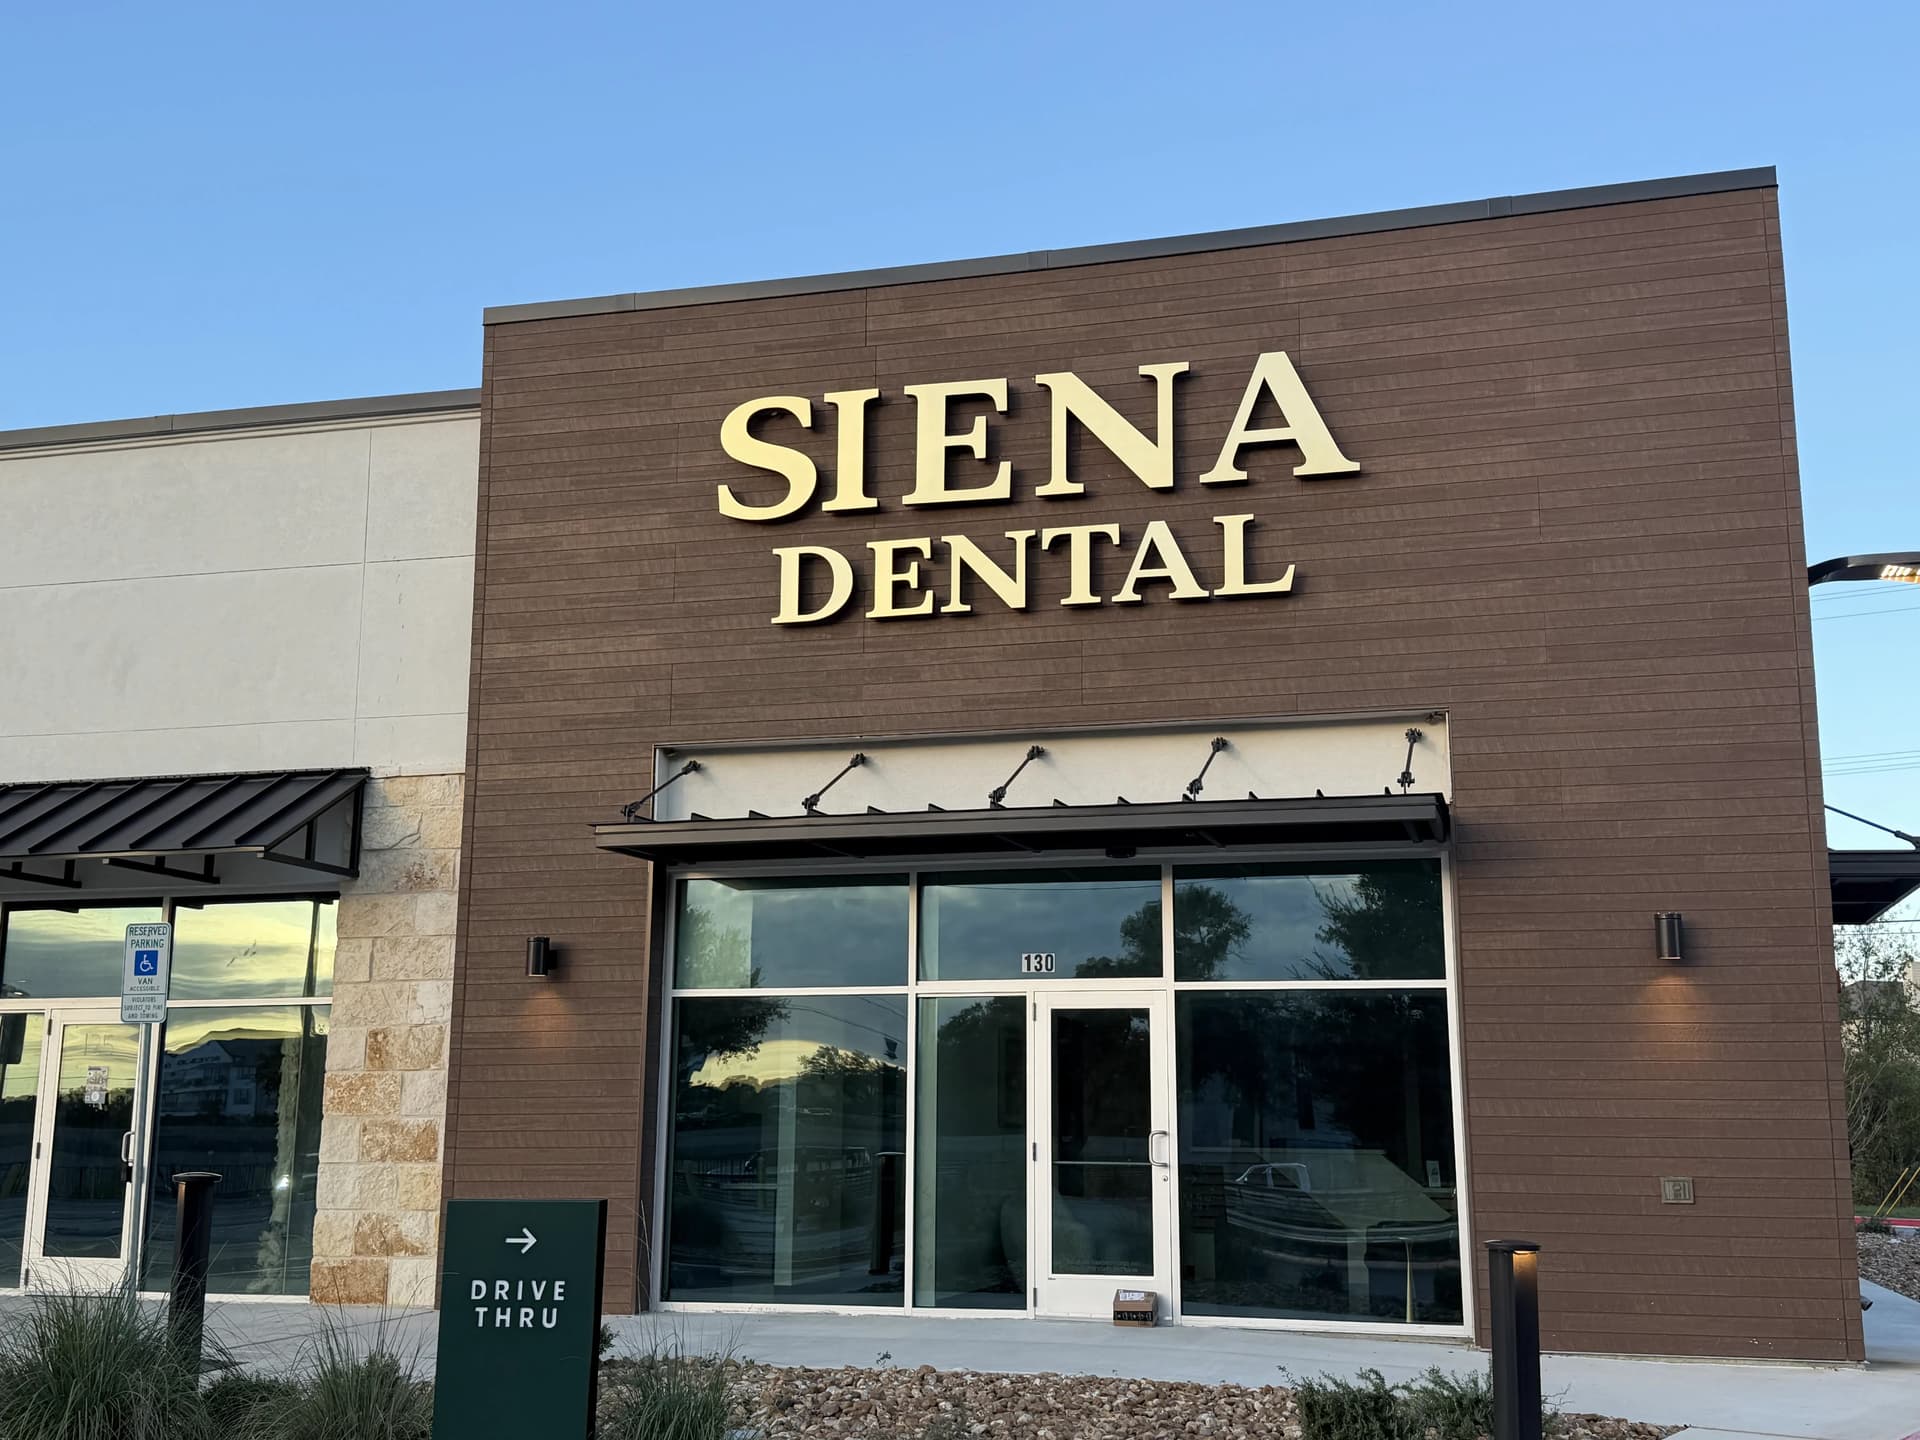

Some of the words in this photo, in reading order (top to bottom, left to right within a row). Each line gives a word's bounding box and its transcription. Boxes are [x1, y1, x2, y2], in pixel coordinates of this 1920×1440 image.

[717, 351, 1361, 521] SIENA
[771, 513, 1295, 625] DENTAL
[129, 926, 167, 936] RESERVED
[130, 939, 164, 948] PARKING
[1024, 954, 1054, 972] 130
[470, 1279, 566, 1301] DRIVE
[475, 1306, 558, 1329] THRU
